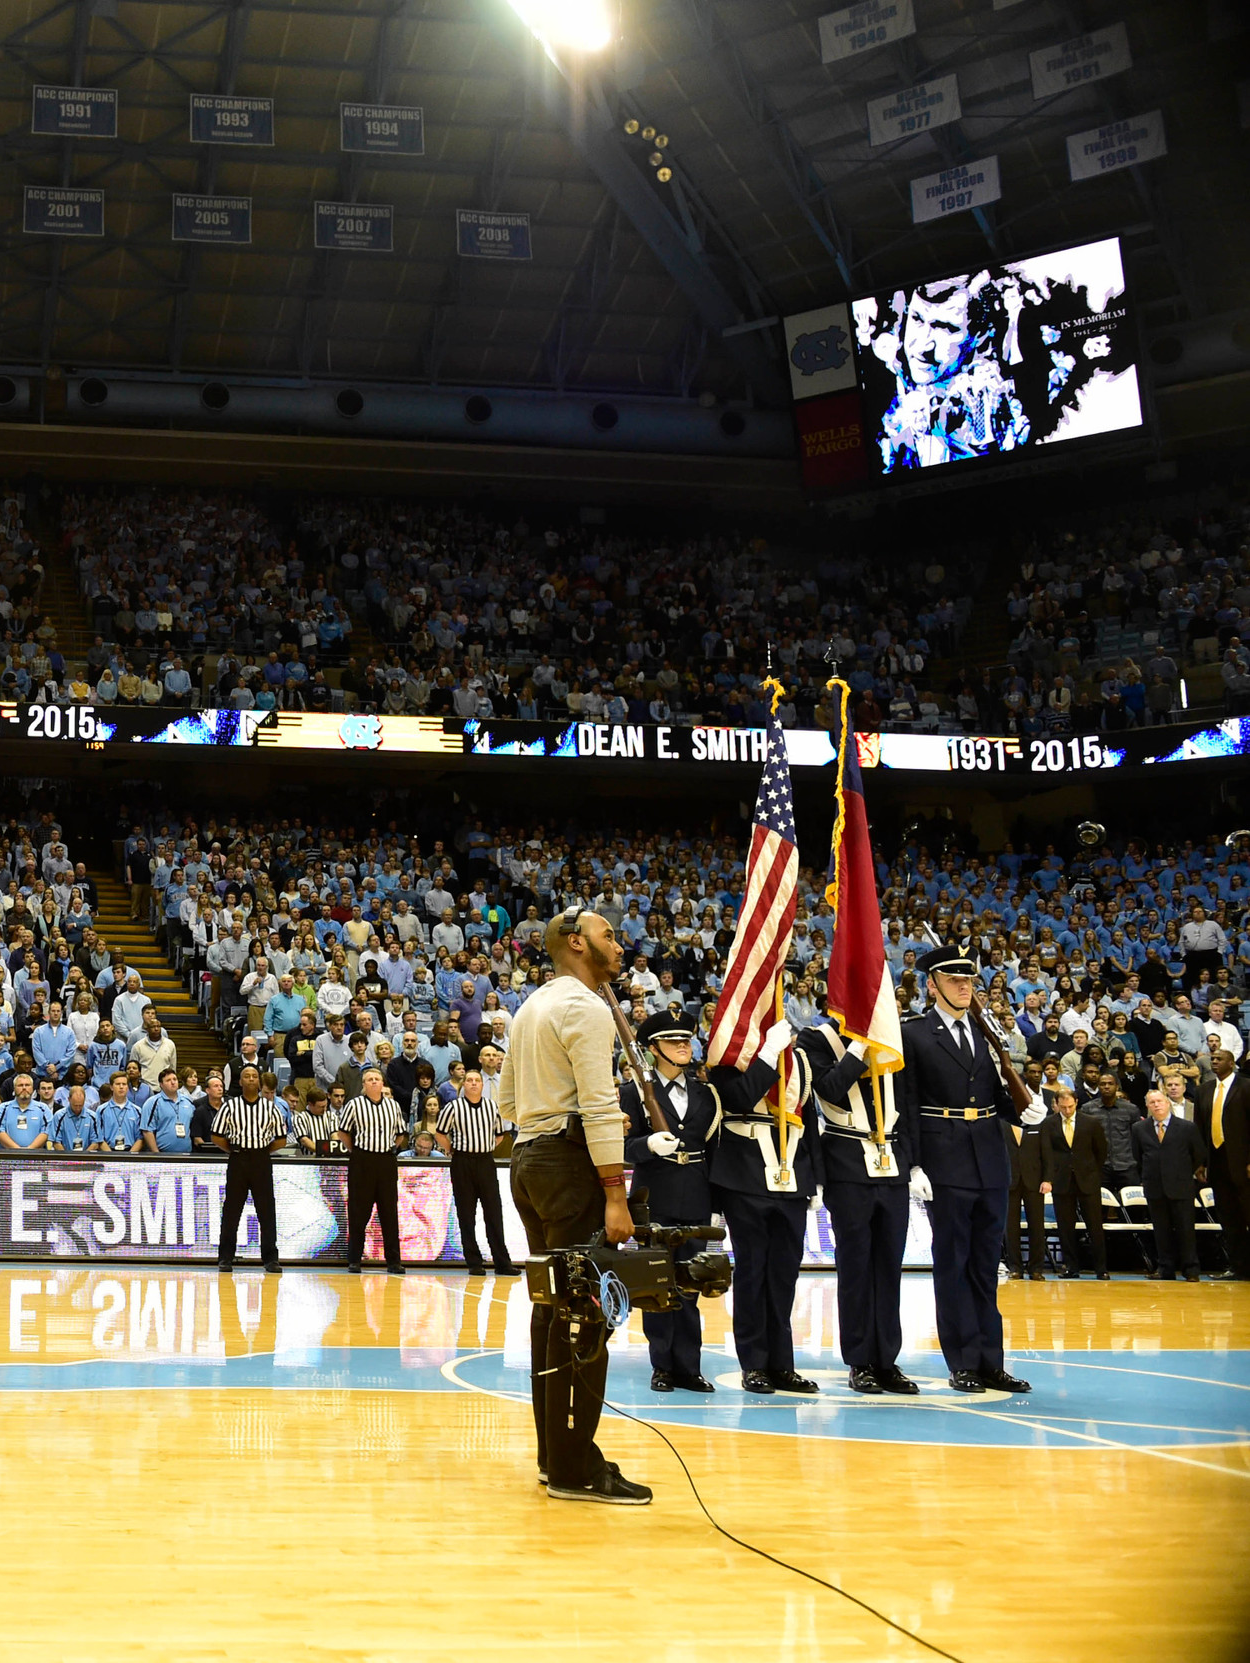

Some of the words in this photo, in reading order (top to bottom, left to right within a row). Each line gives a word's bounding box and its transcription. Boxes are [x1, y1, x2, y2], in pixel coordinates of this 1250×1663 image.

[36, 89, 56, 100] ACC
[58, 90, 114, 102] CHAMPIONS
[59, 104, 91, 118] 1991
[194, 98, 213, 109] ACC
[214, 99, 270, 111] CHAMPIONS
[883, 103, 912, 120] FINAL
[915, 92, 943, 110] FOUR
[214, 112, 249, 127] 1993
[344, 107, 363, 117] ACC
[364, 109, 419, 120] CHAMPIONS
[365, 122, 398, 135] 1994
[898, 111, 930, 132] 1977
[1084, 138, 1114, 156] FINAL
[939, 167, 969, 183] NCAA
[926, 183, 954, 199] FINAL
[957, 172, 984, 189] FOUR
[28, 190, 47, 199] ACC
[48, 191, 101, 202] CHAMPIONS
[939, 191, 972, 211] 1997
[48, 204, 80, 217] 2001
[176, 198, 194, 207] ACC
[196, 199, 248, 209] CHAMPIONS
[195, 211, 229, 224] 2005
[318, 205, 337, 215] ACC
[338, 206, 390, 218] CHAMPIONS
[337, 220, 371, 233] 2007
[460, 214, 478, 223] ACC
[479, 215, 528, 226] CHAMPIONS
[478, 228, 510, 241] 2008
[1060, 322, 1071, 330] IN
[1072, 308, 1126, 327] MEMORIAM
[802, 424, 860, 445] WELLS
[806, 436, 861, 457] FARGO
[27, 705, 96, 739] 2015
[578, 724, 645, 758] DEAN
[656, 727, 679, 759] E.
[692, 728, 767, 762] SMITH
[948, 738, 1006, 771] 1931
[1031, 735, 1103, 772] 2015
[98, 1051, 118, 1059] TAR
[11, 1171, 59, 1243] E.
